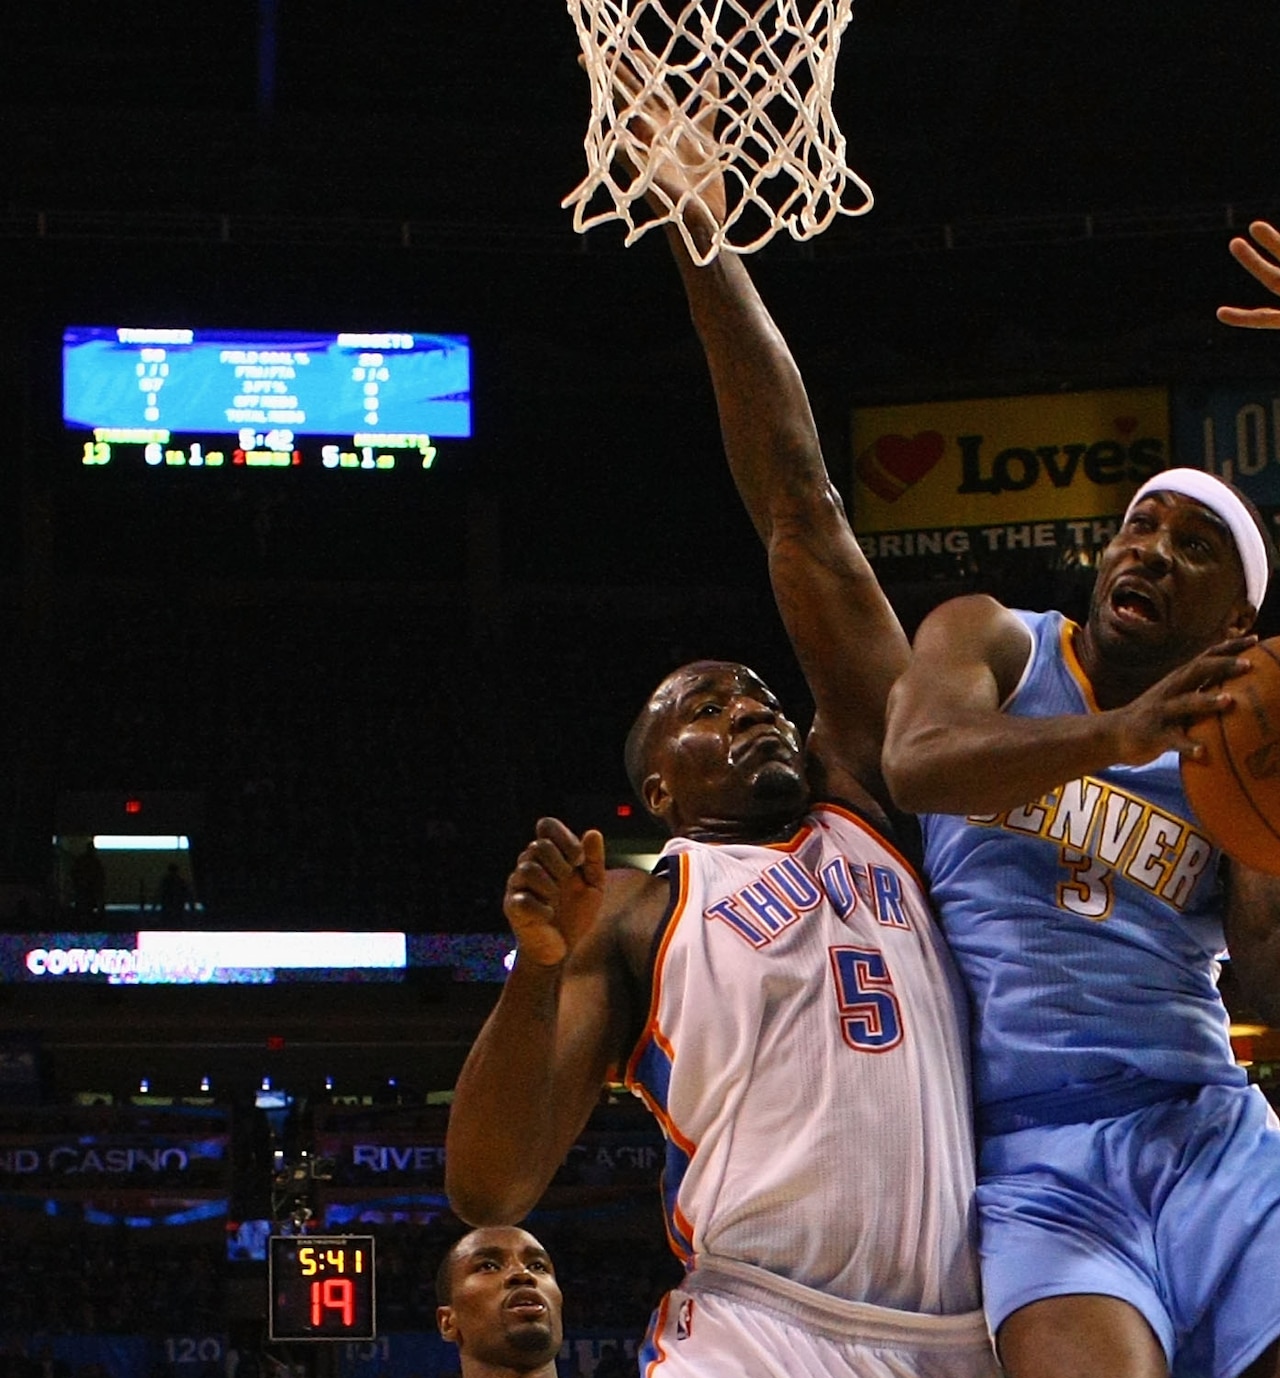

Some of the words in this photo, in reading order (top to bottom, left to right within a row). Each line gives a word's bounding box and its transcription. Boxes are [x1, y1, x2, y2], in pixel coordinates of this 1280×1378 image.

[83, 442, 110, 464] 13
[420, 447, 436, 467] 7
[239, 428, 293, 451] 5:42
[981, 523, 1057, 550] THE
[1066, 519, 1119, 544] TH
[967, 776, 1213, 912] ENVER
[1057, 846, 1115, 921] 3
[828, 945, 904, 1054] 5
[48, 1147, 188, 1174] CASINO
[299, 1247, 362, 1276] 5:41
[311, 1278, 354, 1328] 19
[165, 1338, 222, 1363] 120
